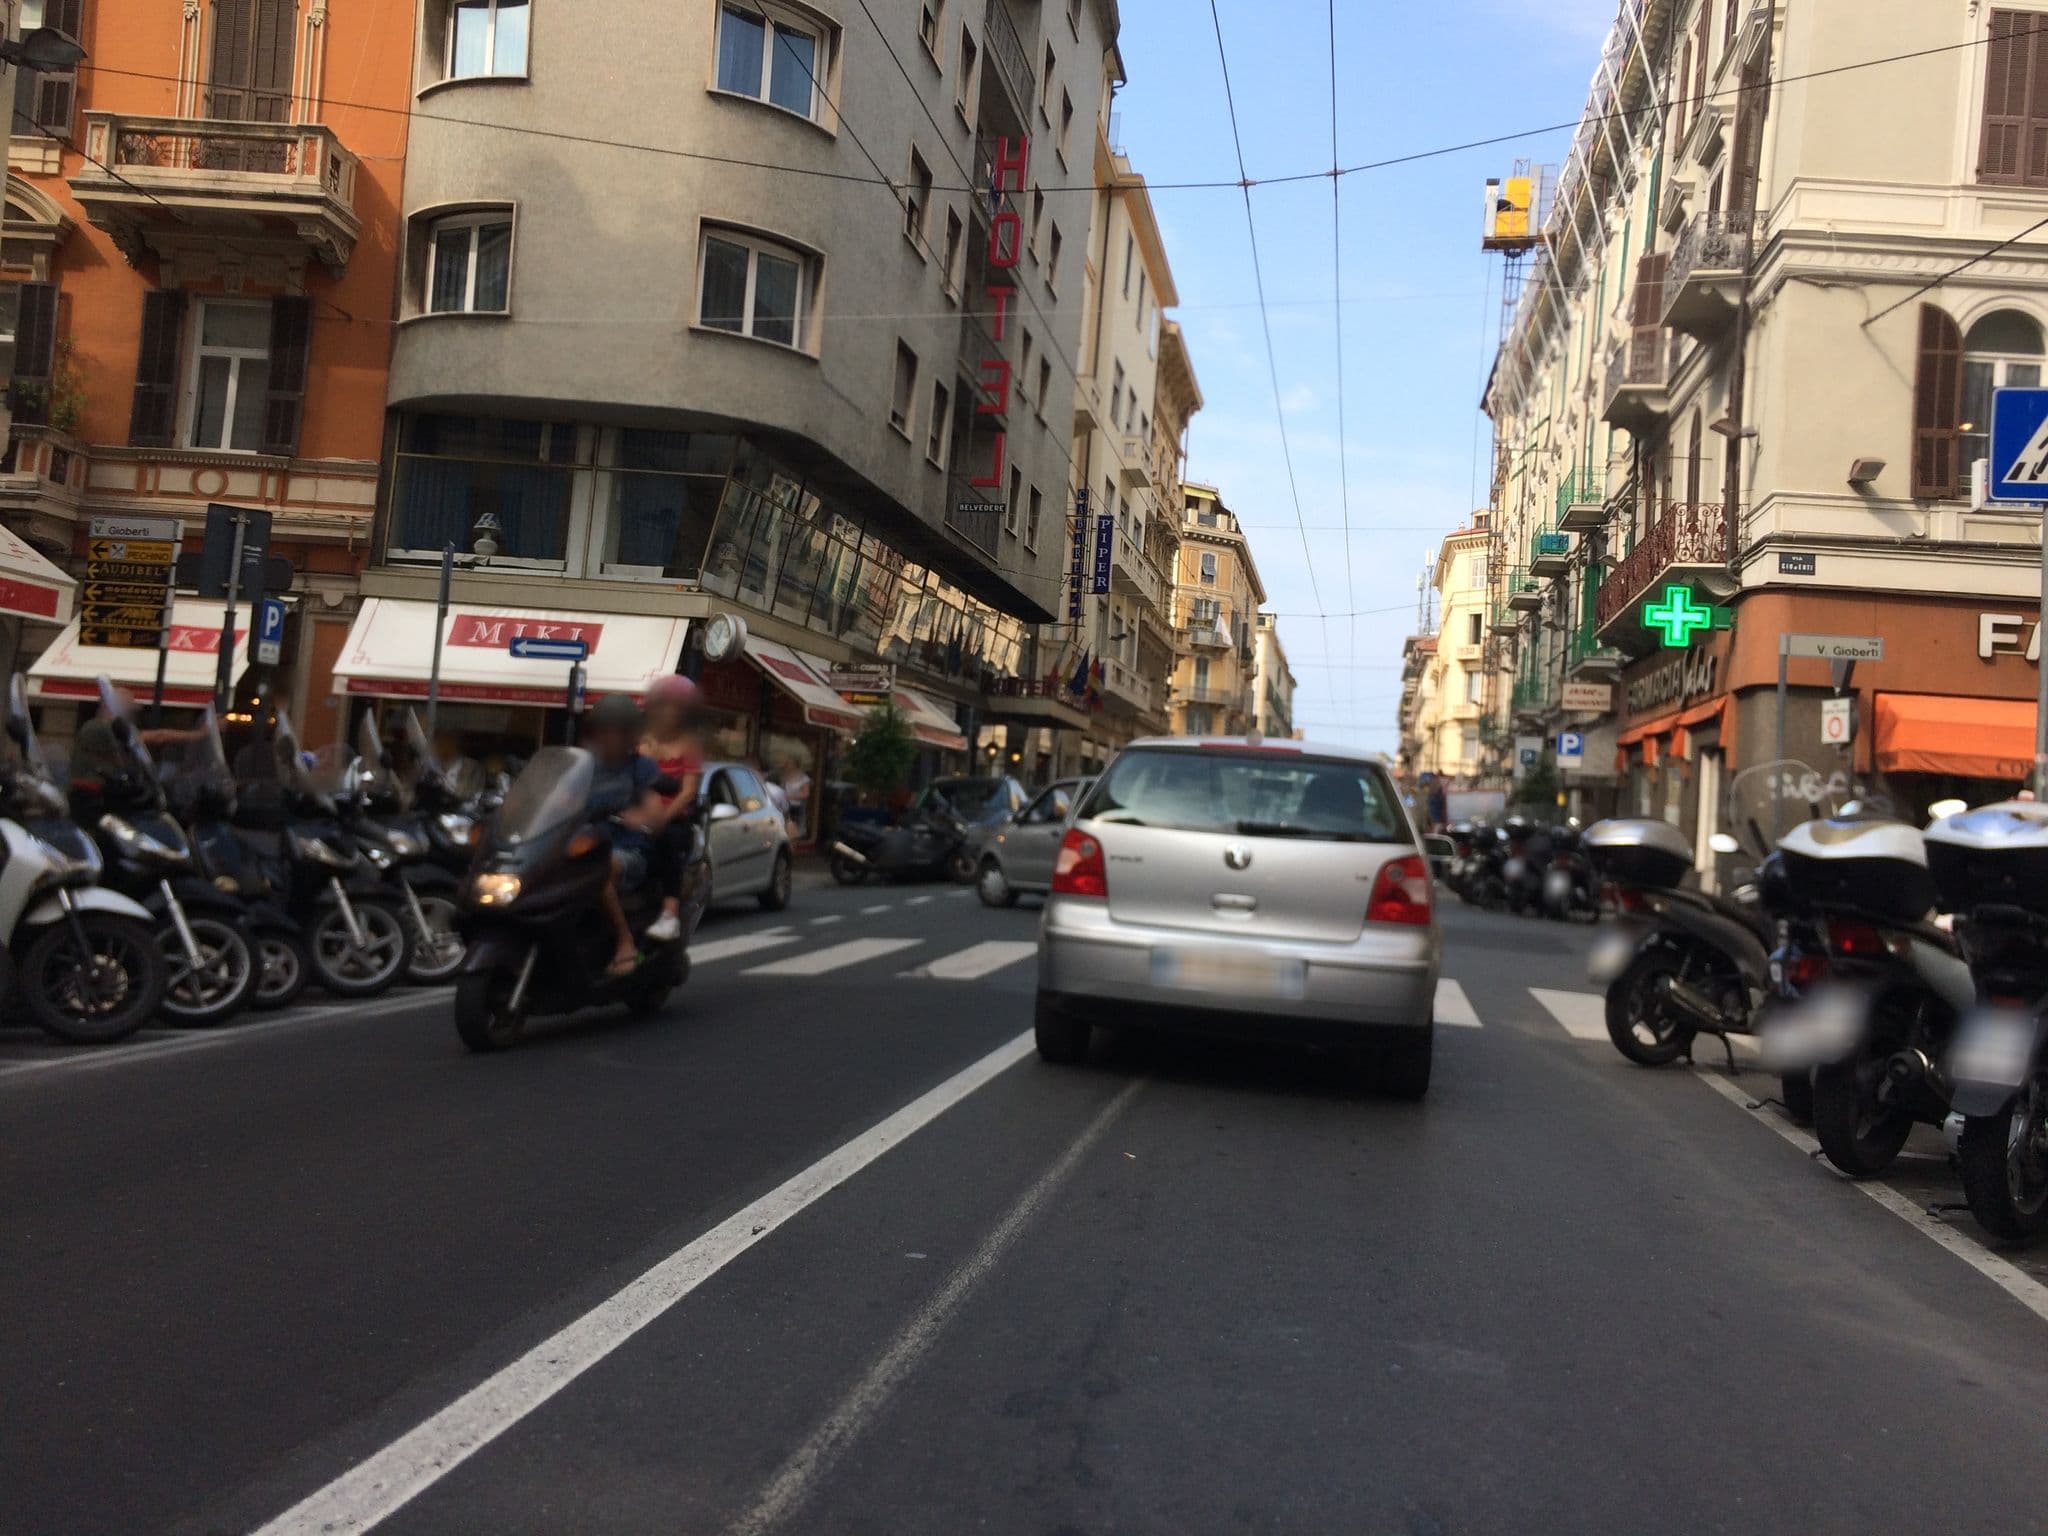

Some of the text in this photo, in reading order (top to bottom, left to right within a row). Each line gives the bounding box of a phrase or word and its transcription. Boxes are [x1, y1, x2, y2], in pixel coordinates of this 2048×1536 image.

[108, 526, 150, 536] Gioberti
[1096, 519, 1110, 588] PIPER
[264, 606, 280, 637] P
[467, 621, 584, 645] MIKI
[1833, 646, 1879, 657] Gioberti
[1561, 733, 1579, 753] P
